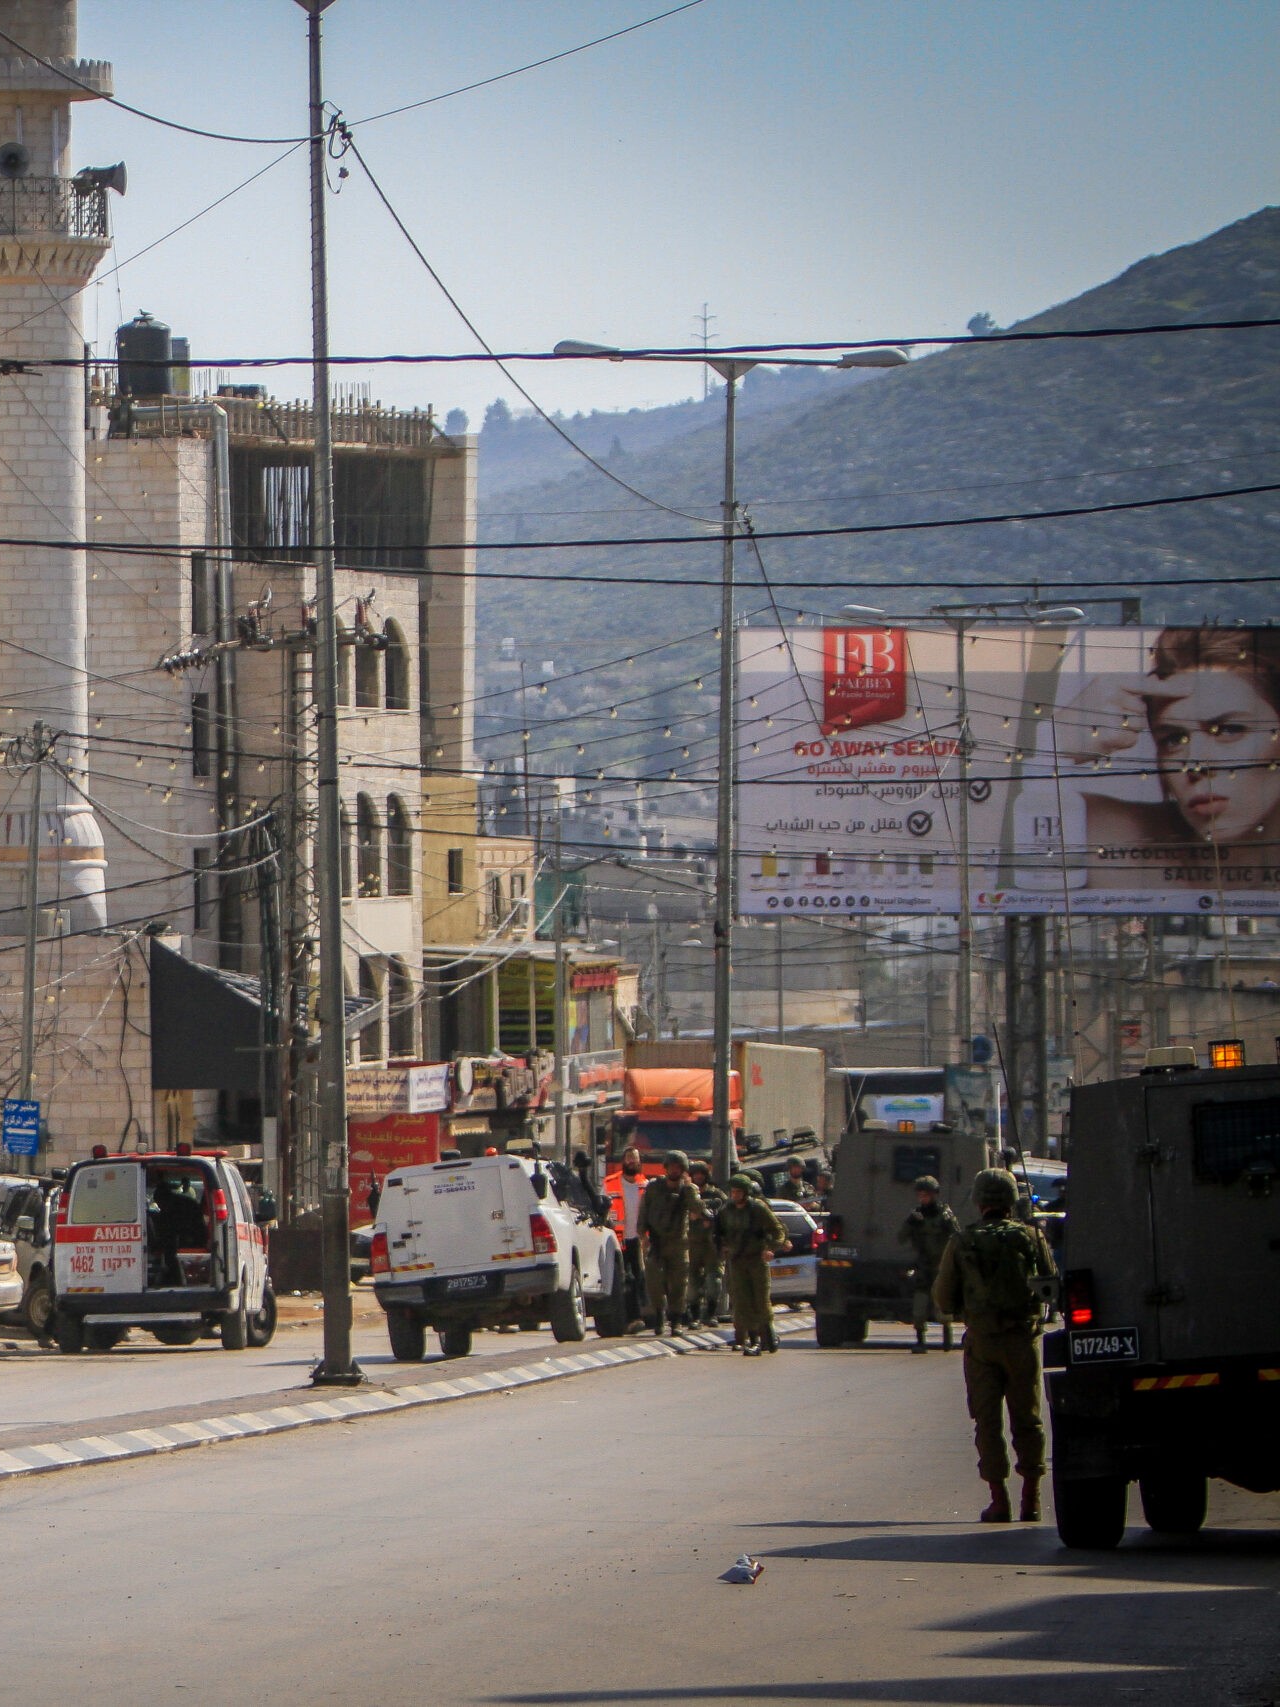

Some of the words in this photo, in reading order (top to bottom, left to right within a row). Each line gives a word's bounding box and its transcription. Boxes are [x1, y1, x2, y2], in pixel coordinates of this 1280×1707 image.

[832, 633, 895, 675] FB
[794, 740, 825, 757] GO
[830, 740, 888, 757] AWAY
[857, 763, 896, 778] مقشر
[818, 818, 841, 831] حب
[845, 818, 866, 833] من
[94, 1226, 141, 1241] AMBU
[70, 1255, 95, 1273] 1462
[101, 1256, 137, 1272] ירקון
